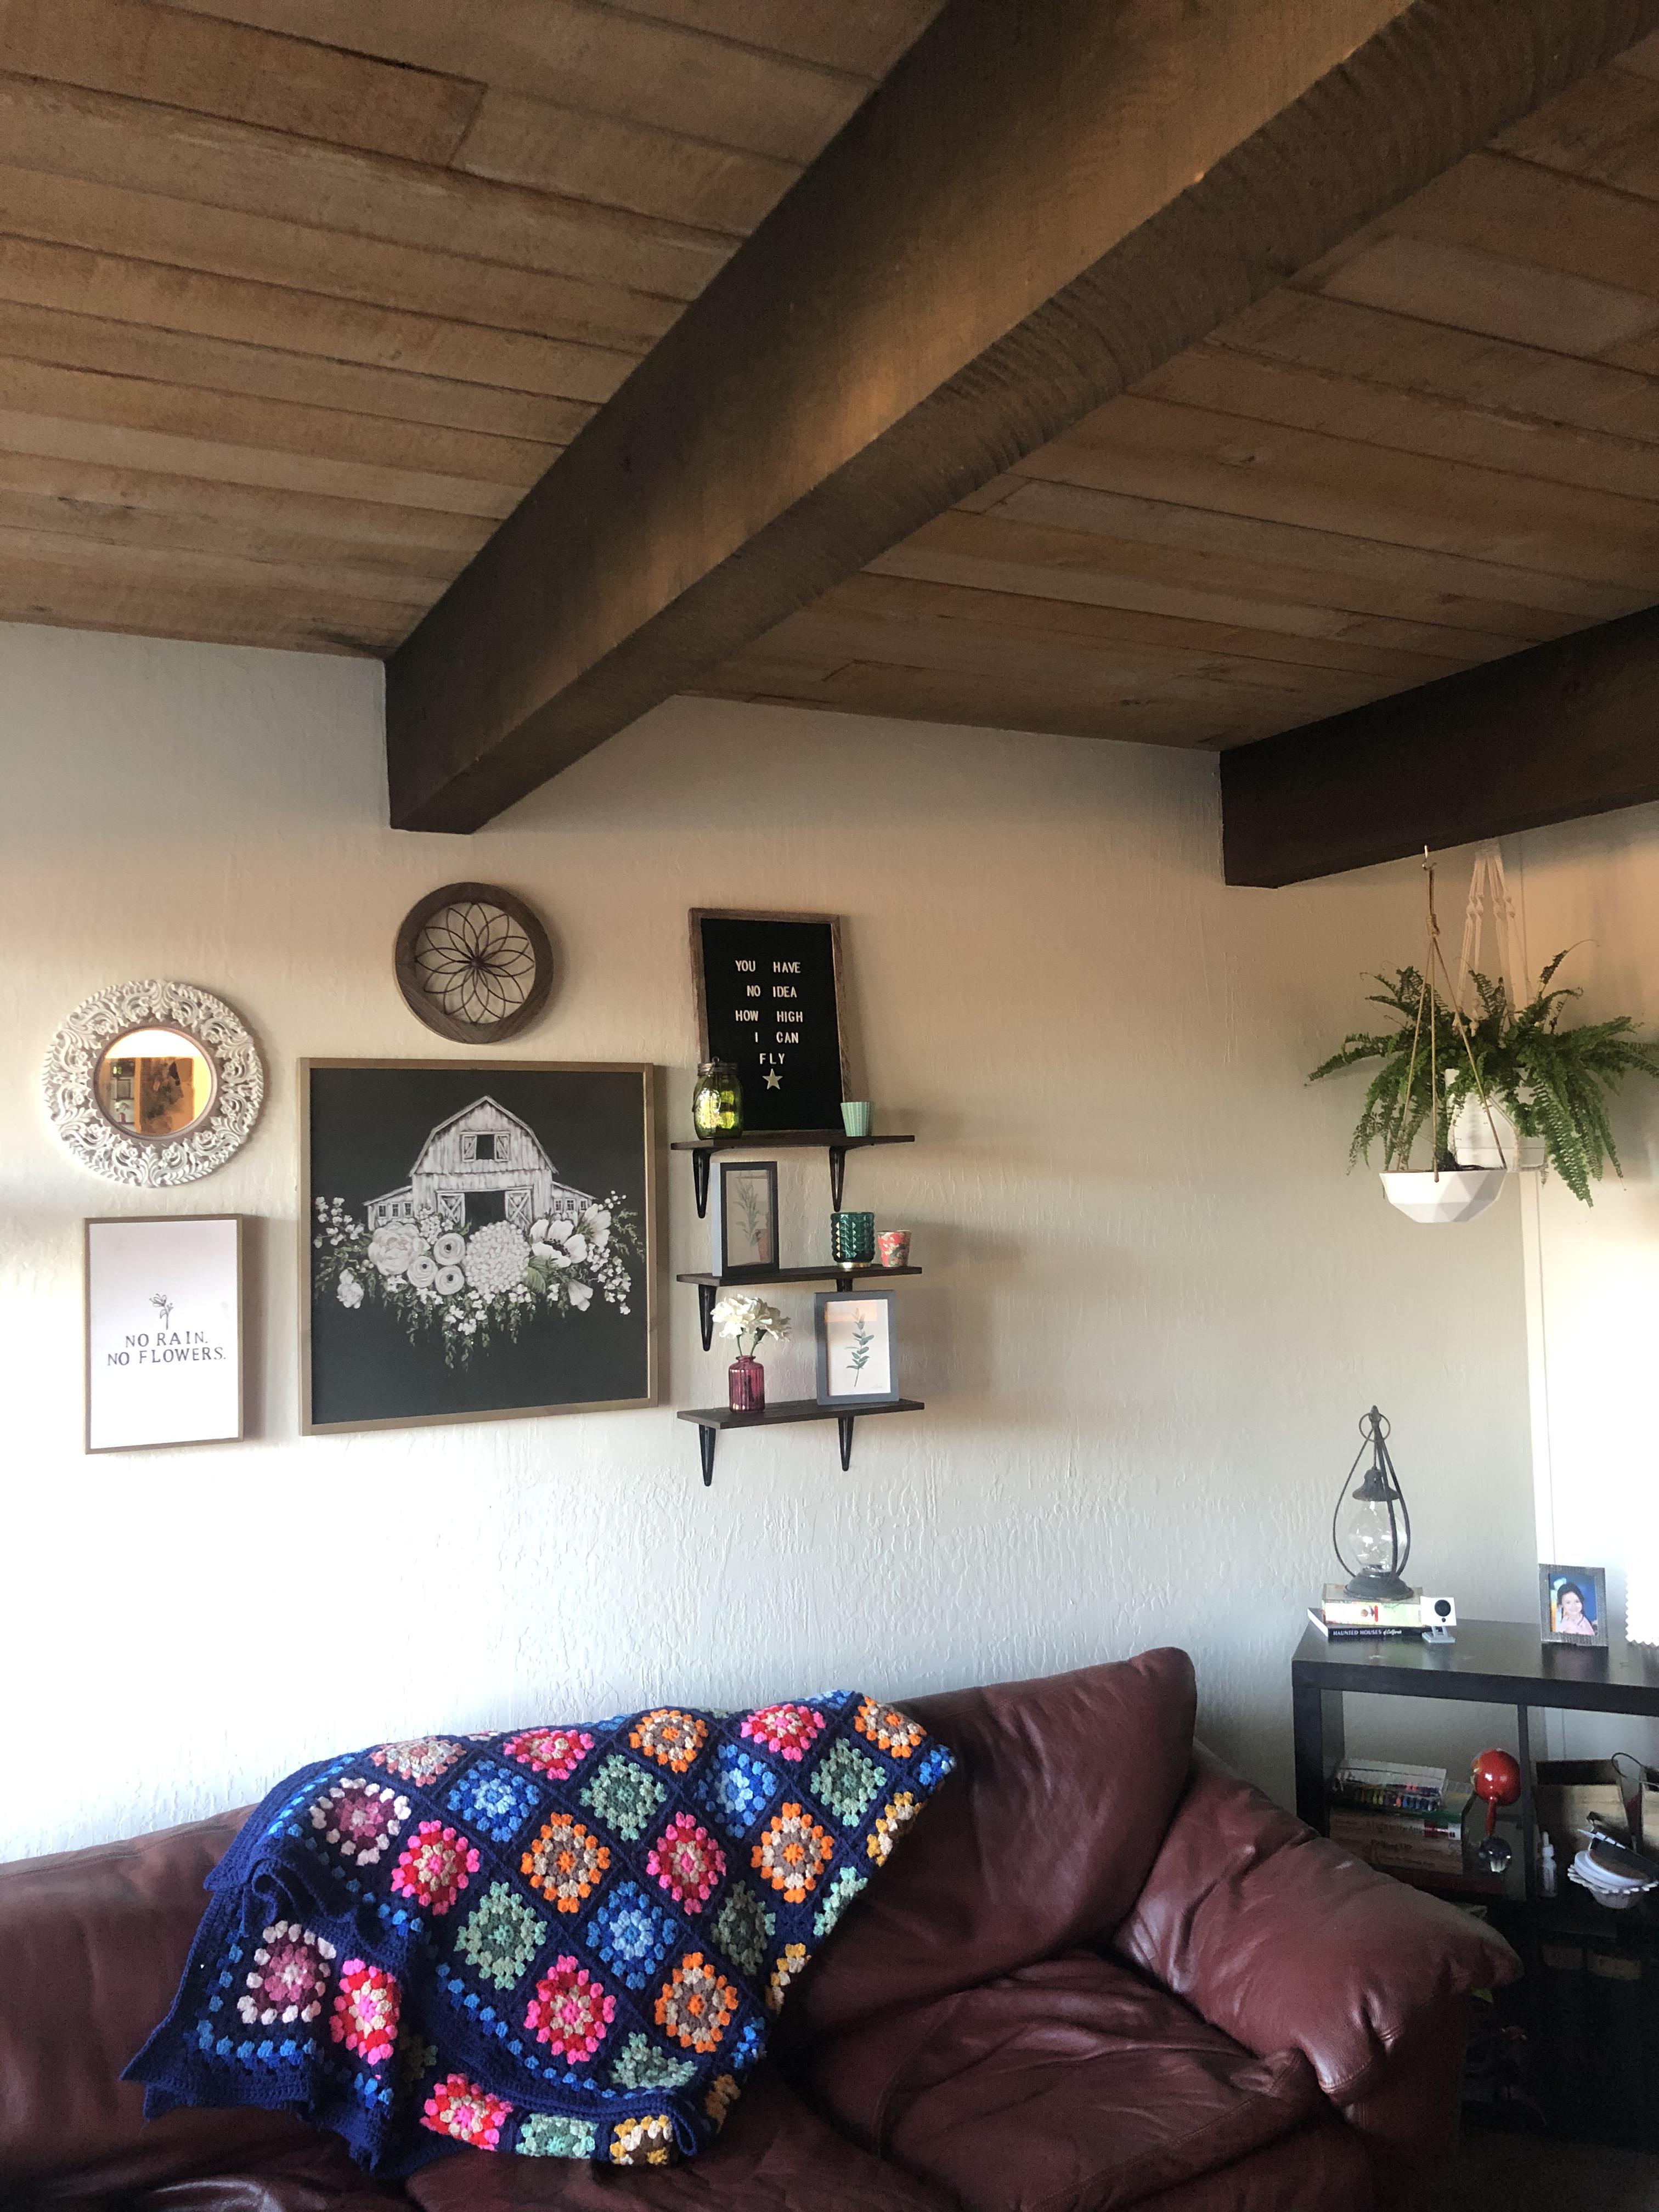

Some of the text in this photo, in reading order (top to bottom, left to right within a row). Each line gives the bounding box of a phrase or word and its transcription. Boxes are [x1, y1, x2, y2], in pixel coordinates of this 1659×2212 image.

[735, 961, 801, 973] YOU HAVE
[747, 985, 797, 997] NO IDEA
[735, 1010, 803, 1023] HOW HIGH
[755, 1032, 799, 1043] I CAN
[759, 1053, 785, 1064] FLY
[125, 1331, 208, 1348] NO RAIN.
[107, 1347, 226, 1365] NO FLOWERS.
